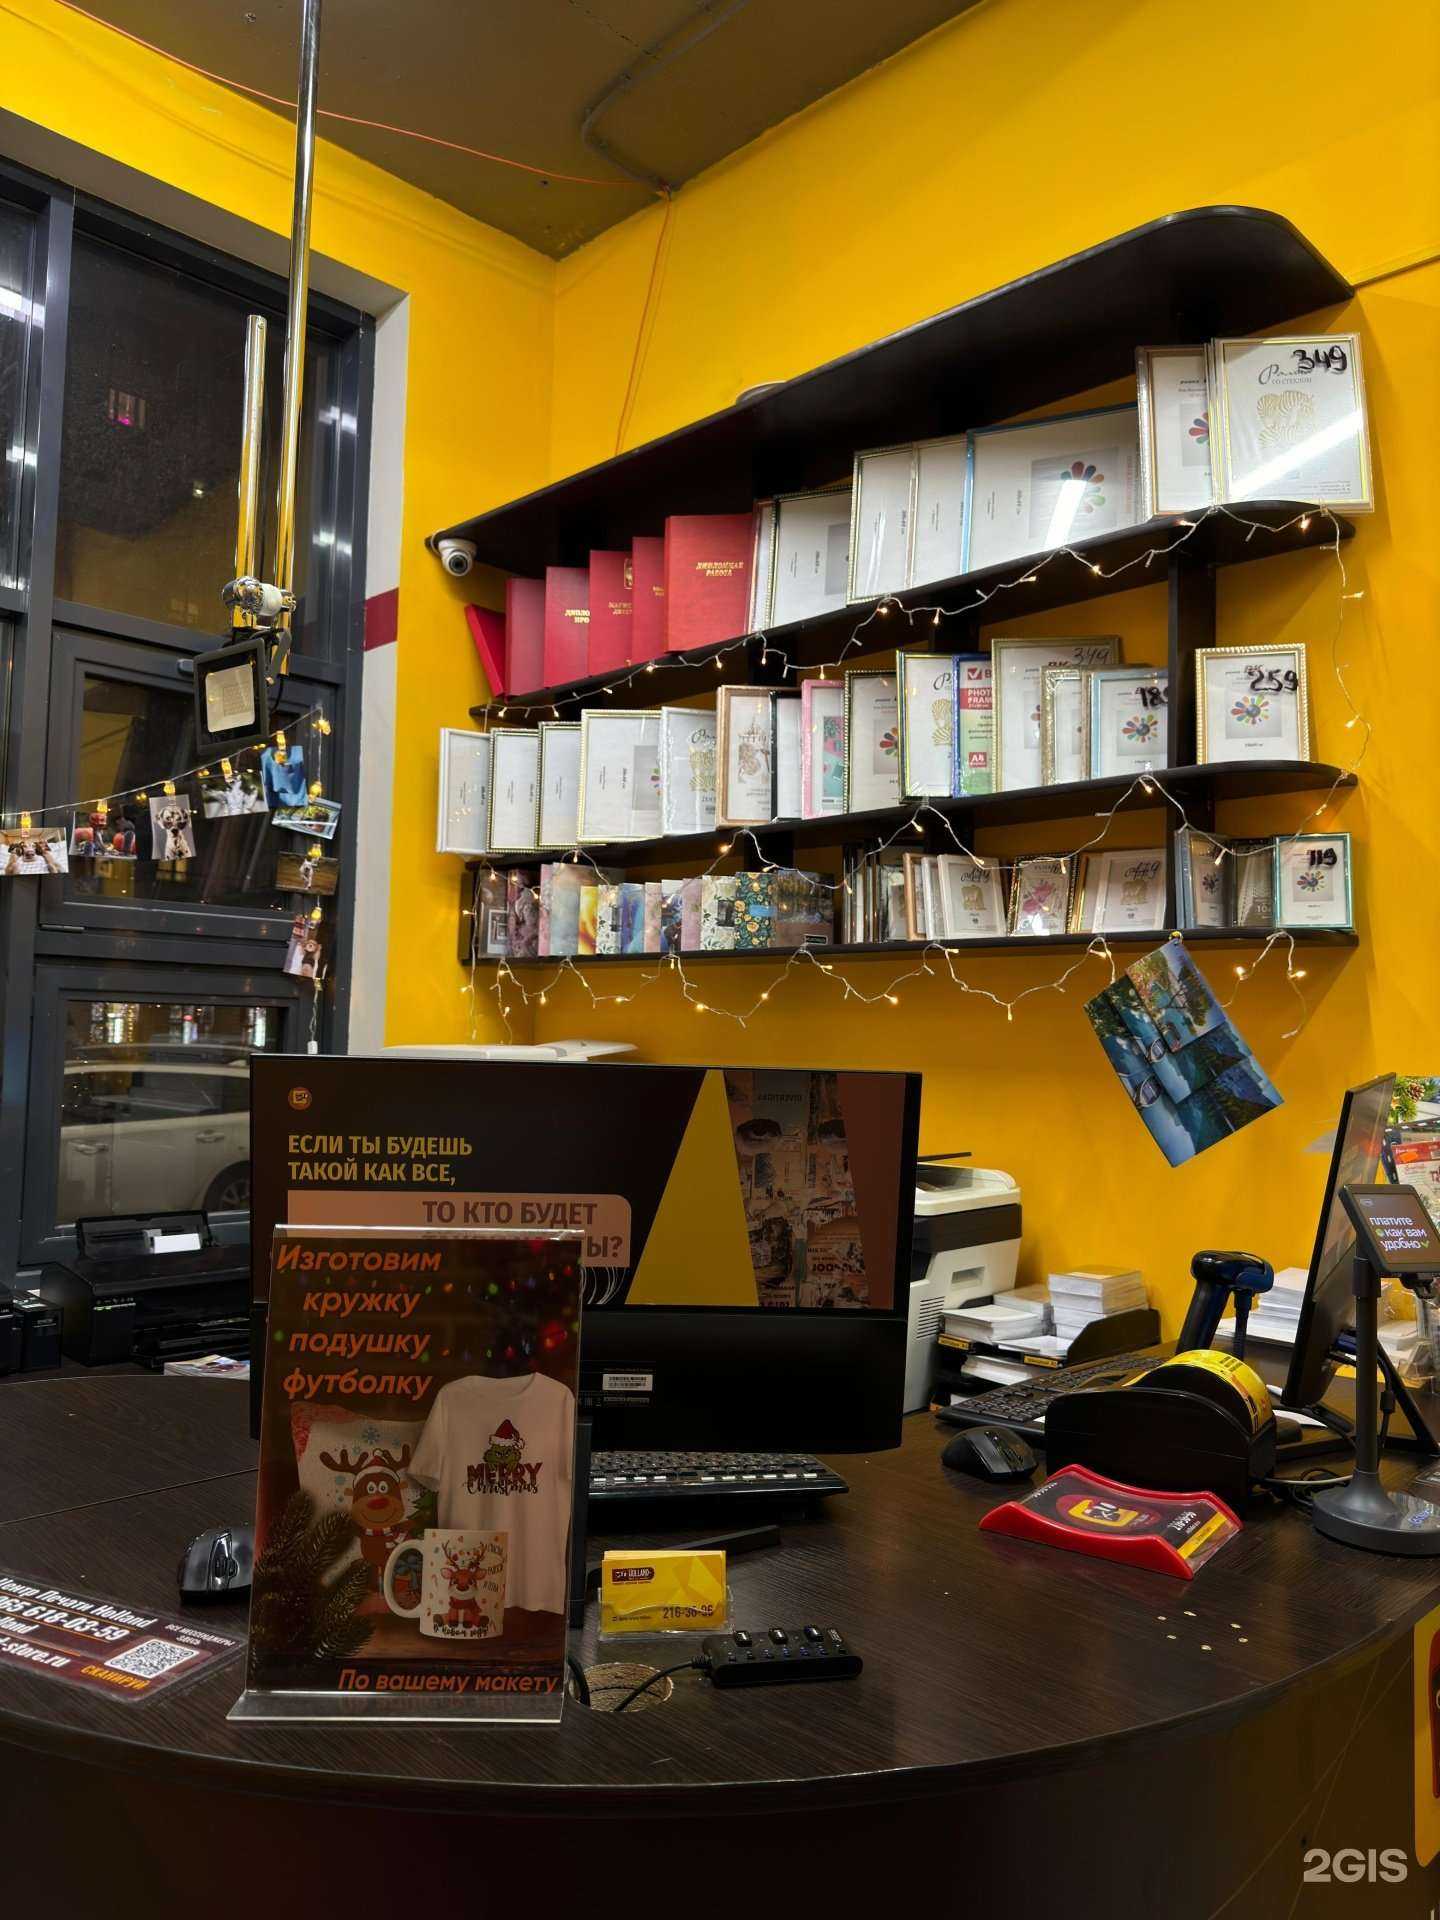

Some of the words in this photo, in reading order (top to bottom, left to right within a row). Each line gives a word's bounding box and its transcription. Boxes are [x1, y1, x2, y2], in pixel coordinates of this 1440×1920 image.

[1293, 345, 1348, 371] 349
[1248, 669, 1298, 692] 259
[288, 1134, 343, 1154] ЕСЛИ
[349, 1136, 381, 1154] ТЫ
[387, 1136, 473, 1160] БУДЕШЬ
[288, 1157, 358, 1181] ТАКОЙ
[364, 1162, 408, 1181] КАК
[412, 1163, 457, 1186] ВСЕ,
[422, 1200, 456, 1223] ТО
[463, 1201, 513, 1224] КТО
[520, 1202, 598, 1228] БУДЕТ
[1369, 1217, 1414, 1226] платите
[1380, 1237, 1421, 1251] удобно
[1384, 1228, 1405, 1237] как
[1406, 1228, 1427, 1238] вам
[276, 1244, 442, 1272] Изготовим
[303, 1291, 421, 1318] кружку
[289, 1332, 431, 1359] подушку
[283, 1367, 433, 1400] футболку
[467, 1462, 543, 1486] MERRY
[36, 1590, 94, 1611] Печати
[90, 1605, 158, 1628] Holland
[22, 1606, 130, 1640] 618-03-59
[80, 1665, 151, 1690] СКАНИРУЙ
[338, 1669, 370, 1690] По
[376, 1674, 470, 1694] вашему
[475, 1676, 558, 1695] макету
